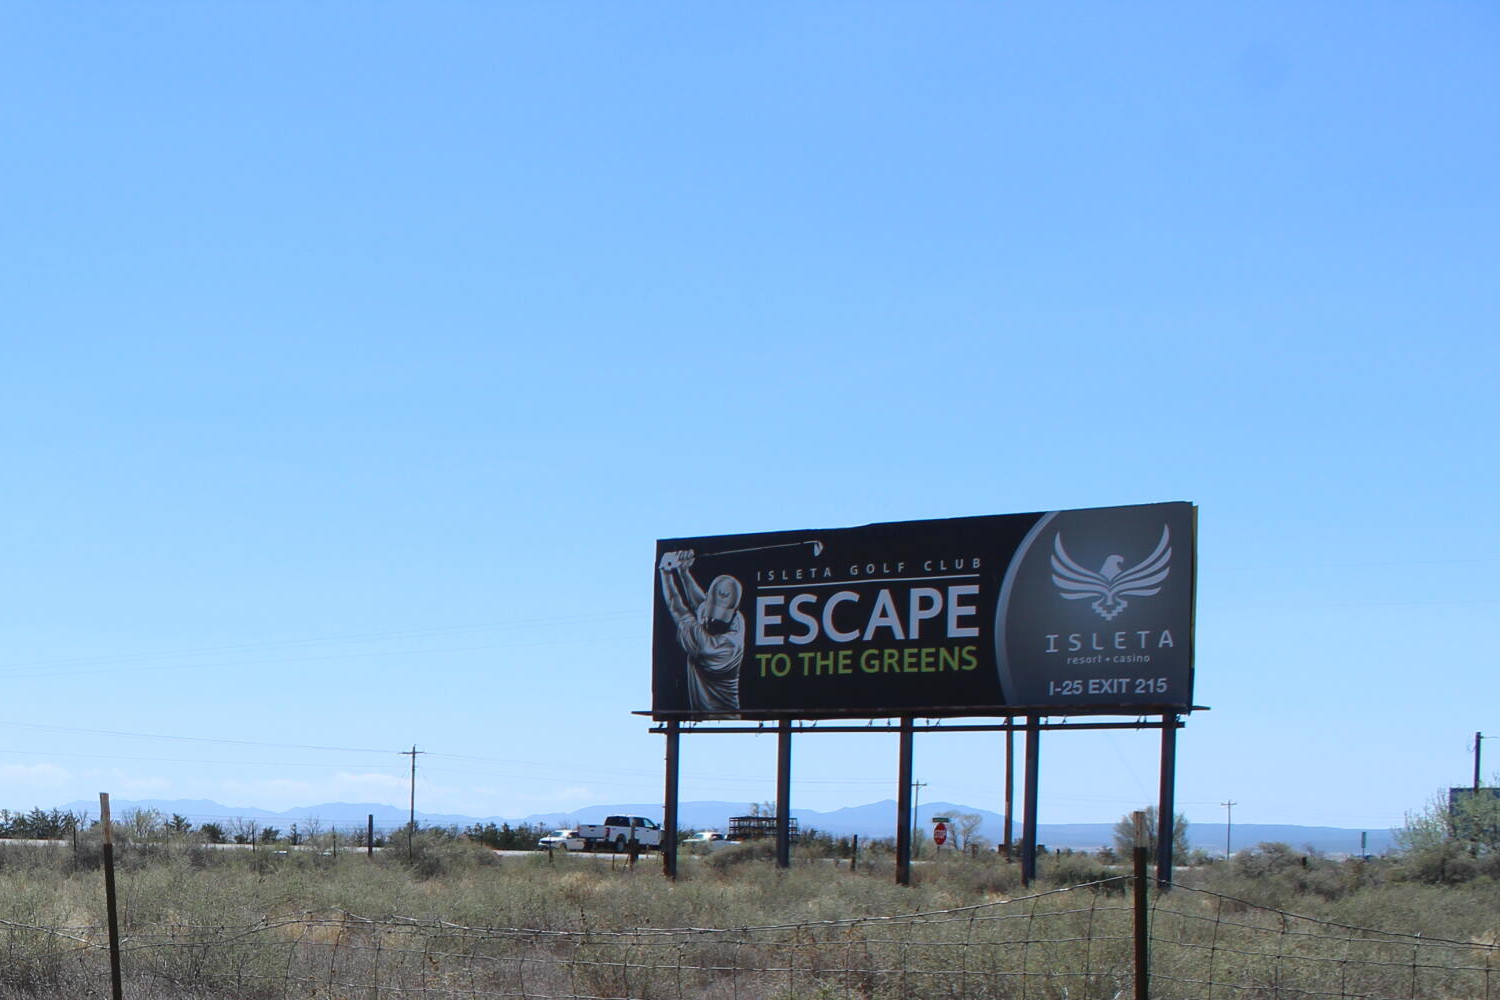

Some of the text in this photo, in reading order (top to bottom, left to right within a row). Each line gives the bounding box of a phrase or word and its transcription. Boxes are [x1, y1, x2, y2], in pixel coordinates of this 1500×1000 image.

[757, 558, 980, 582] ISLETA GOLF CLUB
[755, 584, 980, 646] ESCAPE
[1045, 629, 1174, 653] ISLETA
[755, 645, 979, 677] TO THE GREENS
[1067, 653, 1151, 665] resort casino
[1048, 677, 1168, 696] I-25 EXIT 215
